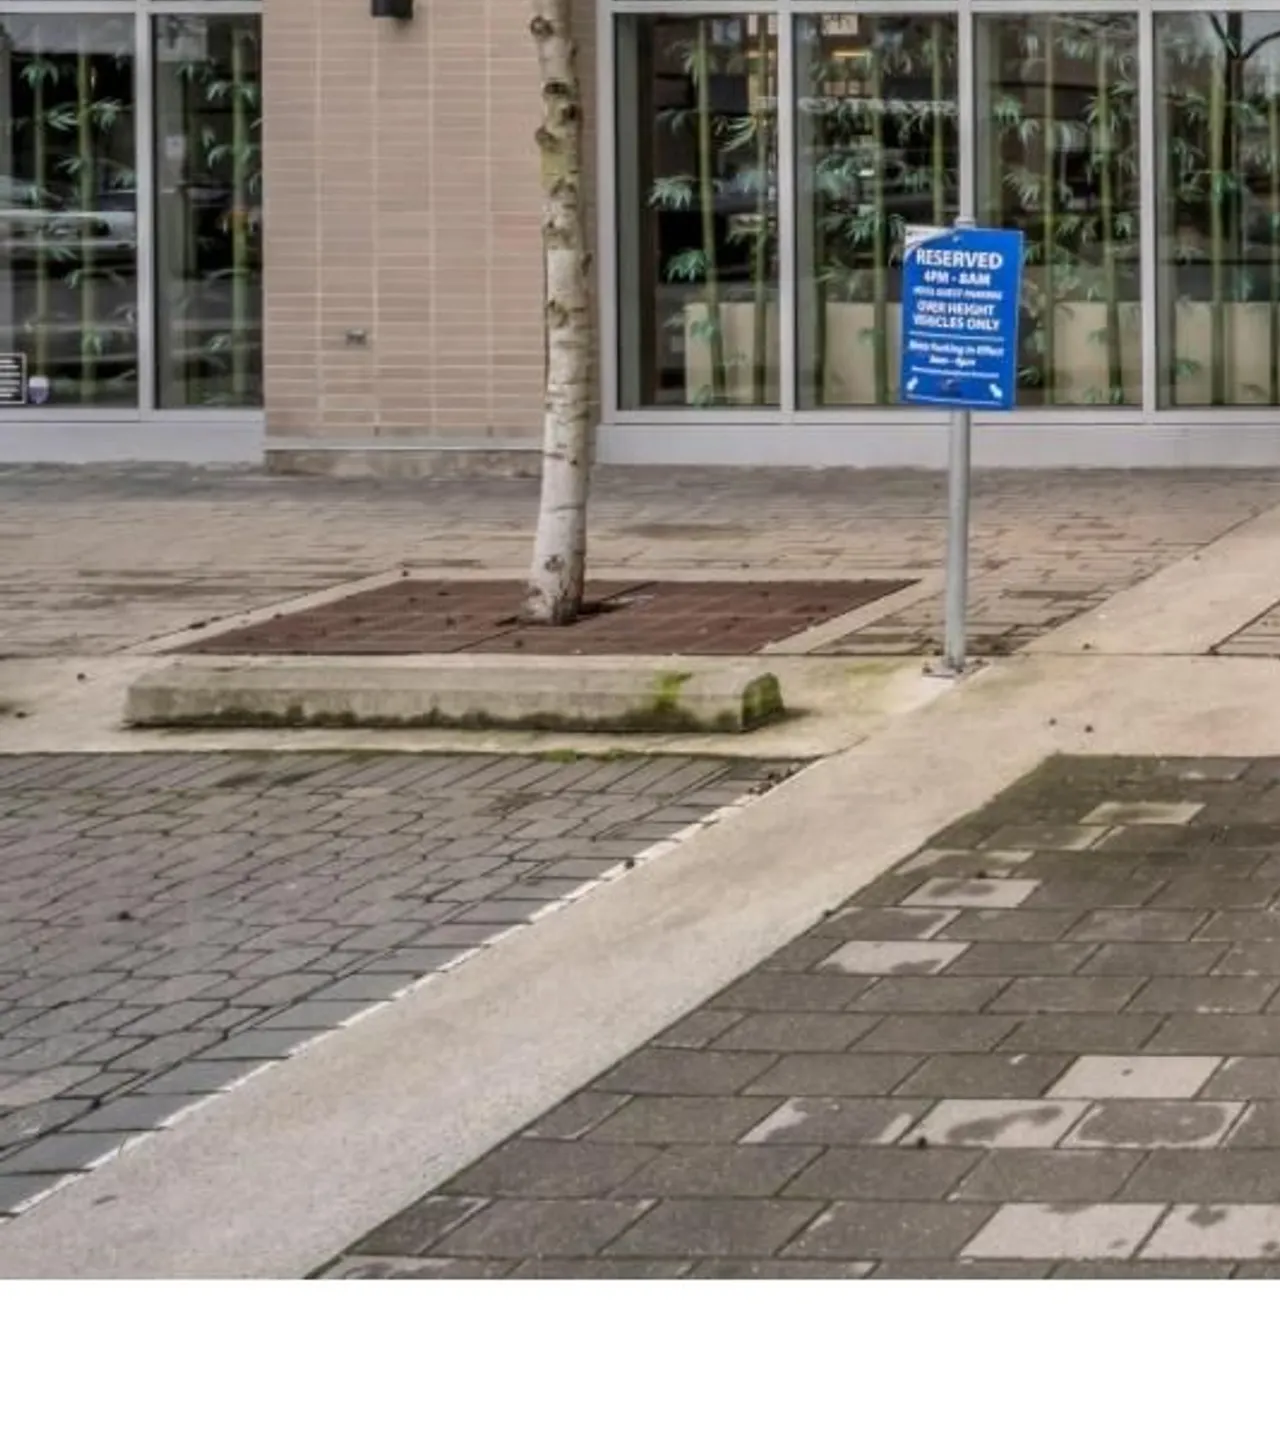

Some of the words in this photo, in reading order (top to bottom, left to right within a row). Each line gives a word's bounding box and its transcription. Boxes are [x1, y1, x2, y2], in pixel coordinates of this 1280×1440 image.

[916, 248, 1003, 270] RESERVED
[917, 300, 946, 315] OVER
[947, 302, 996, 317] HEIGHT
[912, 313, 964, 329] VEHICLES
[966, 317, 1001, 332] ONLY
